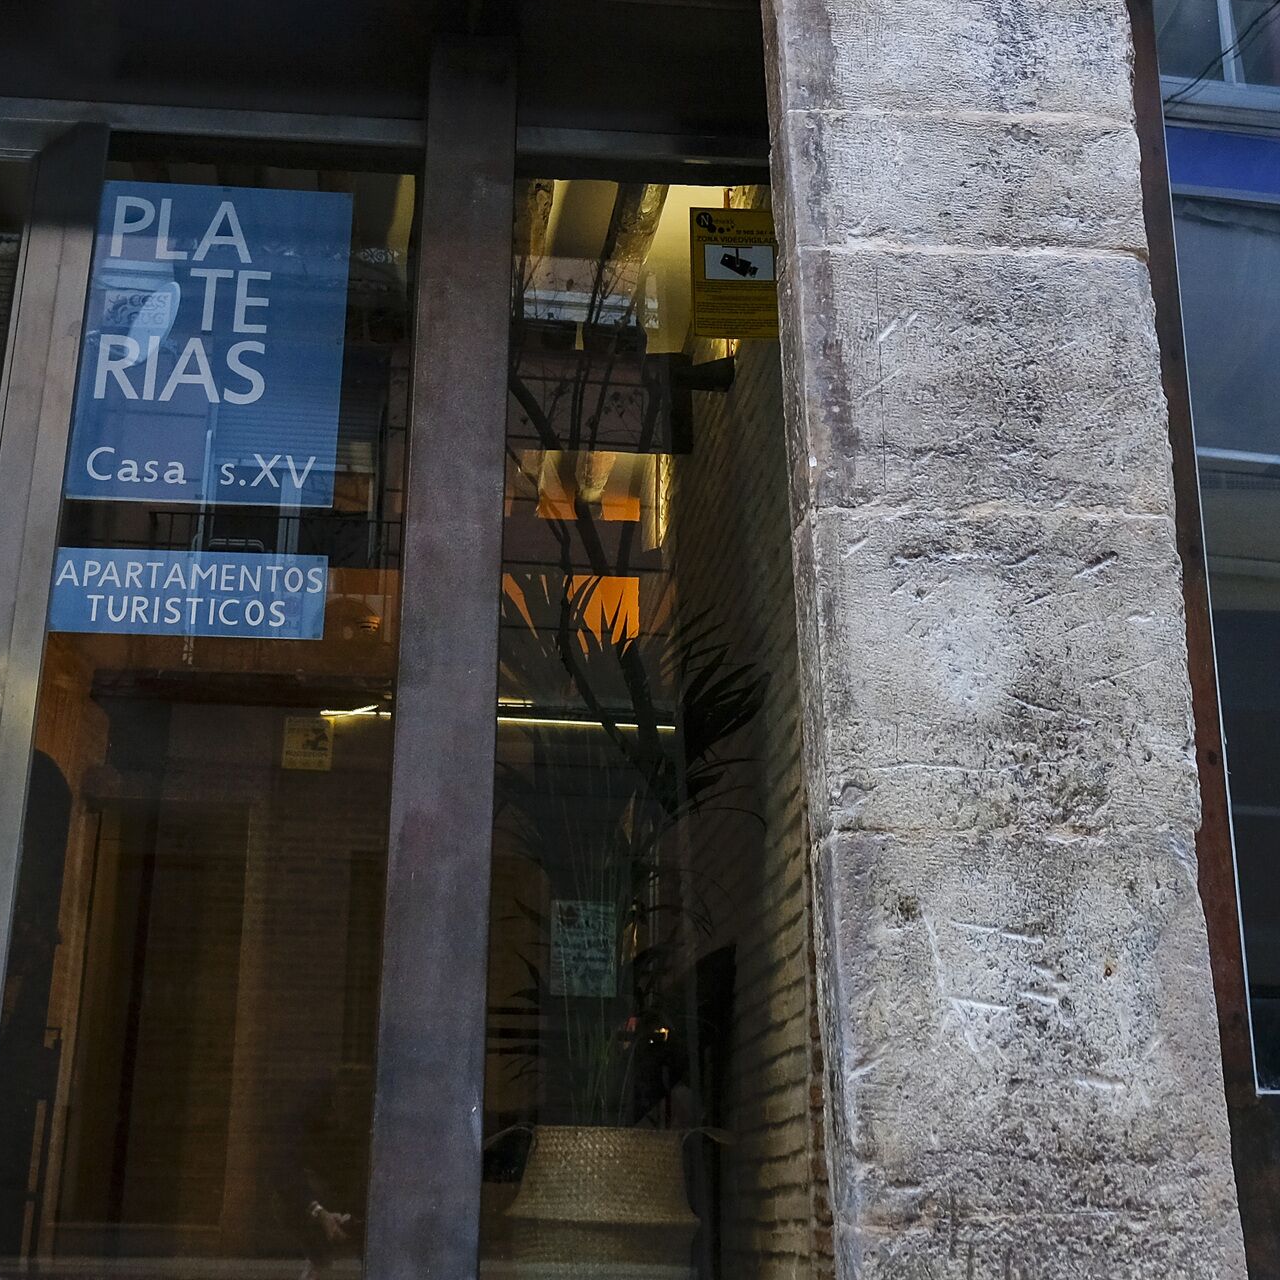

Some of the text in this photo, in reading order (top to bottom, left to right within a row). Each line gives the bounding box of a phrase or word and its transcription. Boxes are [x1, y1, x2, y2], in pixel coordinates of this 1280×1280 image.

[110, 196, 253, 264] PLA
[720, 236, 778, 245] VIDEOVIGILAD
[190, 268, 272, 334] TE
[93, 334, 266, 406] RIAS
[86, 446, 316, 488] Casa s.XV
[55, 559, 324, 595] APARTAMENTOS
[86, 594, 287, 628] TURISTICOS
